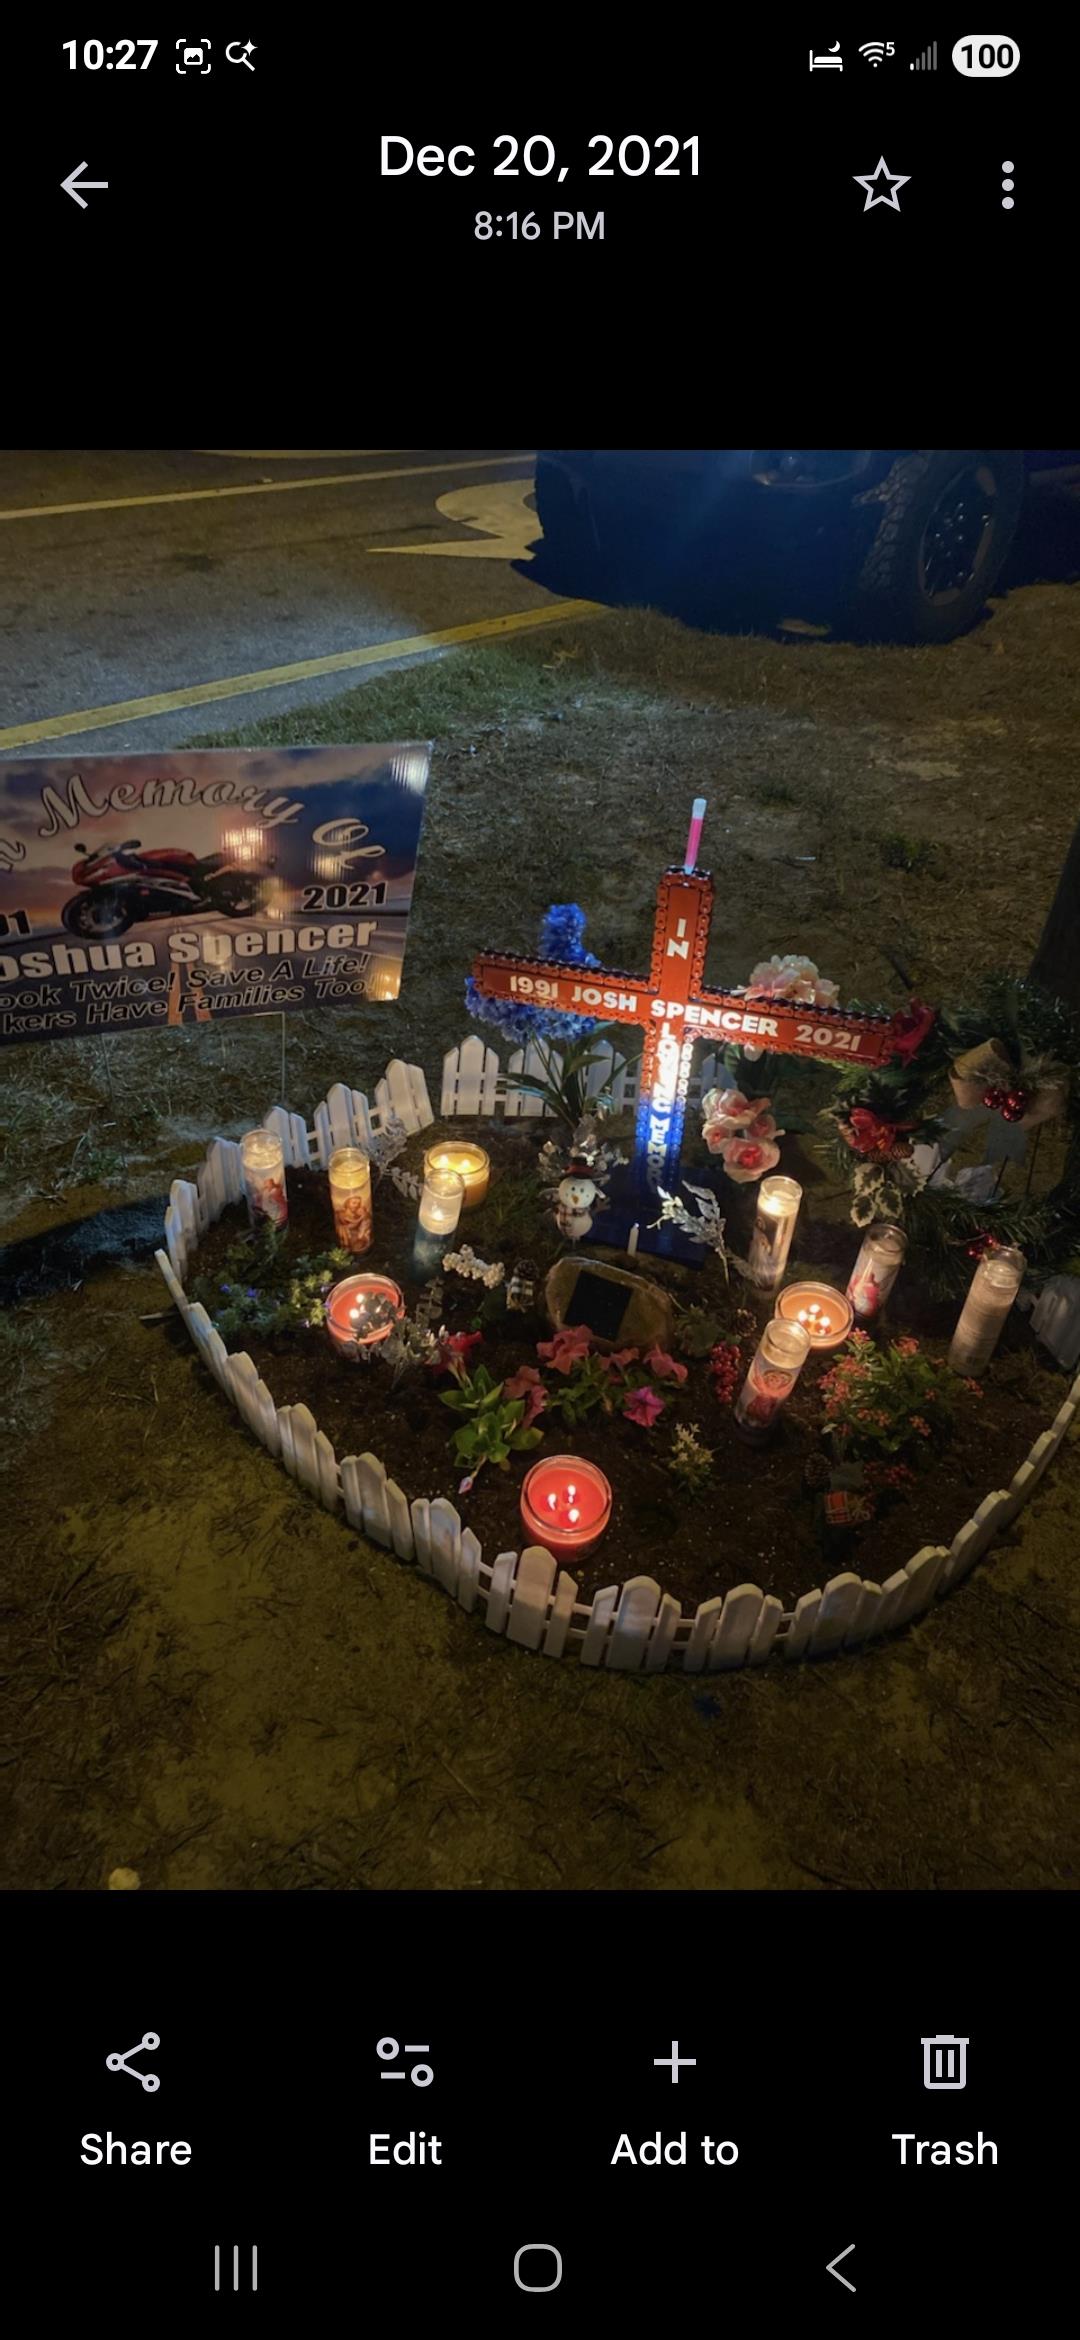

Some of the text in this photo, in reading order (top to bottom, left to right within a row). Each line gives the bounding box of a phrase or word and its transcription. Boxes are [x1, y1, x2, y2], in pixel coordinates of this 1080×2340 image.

[38, 773, 304, 837] Memory
[312, 817, 386, 870] Of
[302, 881, 388, 911] 2021
[0, 921, 378, 982] oshua Spencer
[666, 918, 690, 960] IN
[0, 953, 371, 1011] ook Twice! Save A Life!
[2, 1009, 78, 1035] kers
[86, 998, 168, 1025] Have
[177, 983, 304, 1013] Families
[509, 975, 863, 1051] 1991 JOSH SPENCER 2021
[651, 1022, 680, 1114] LOVNG
